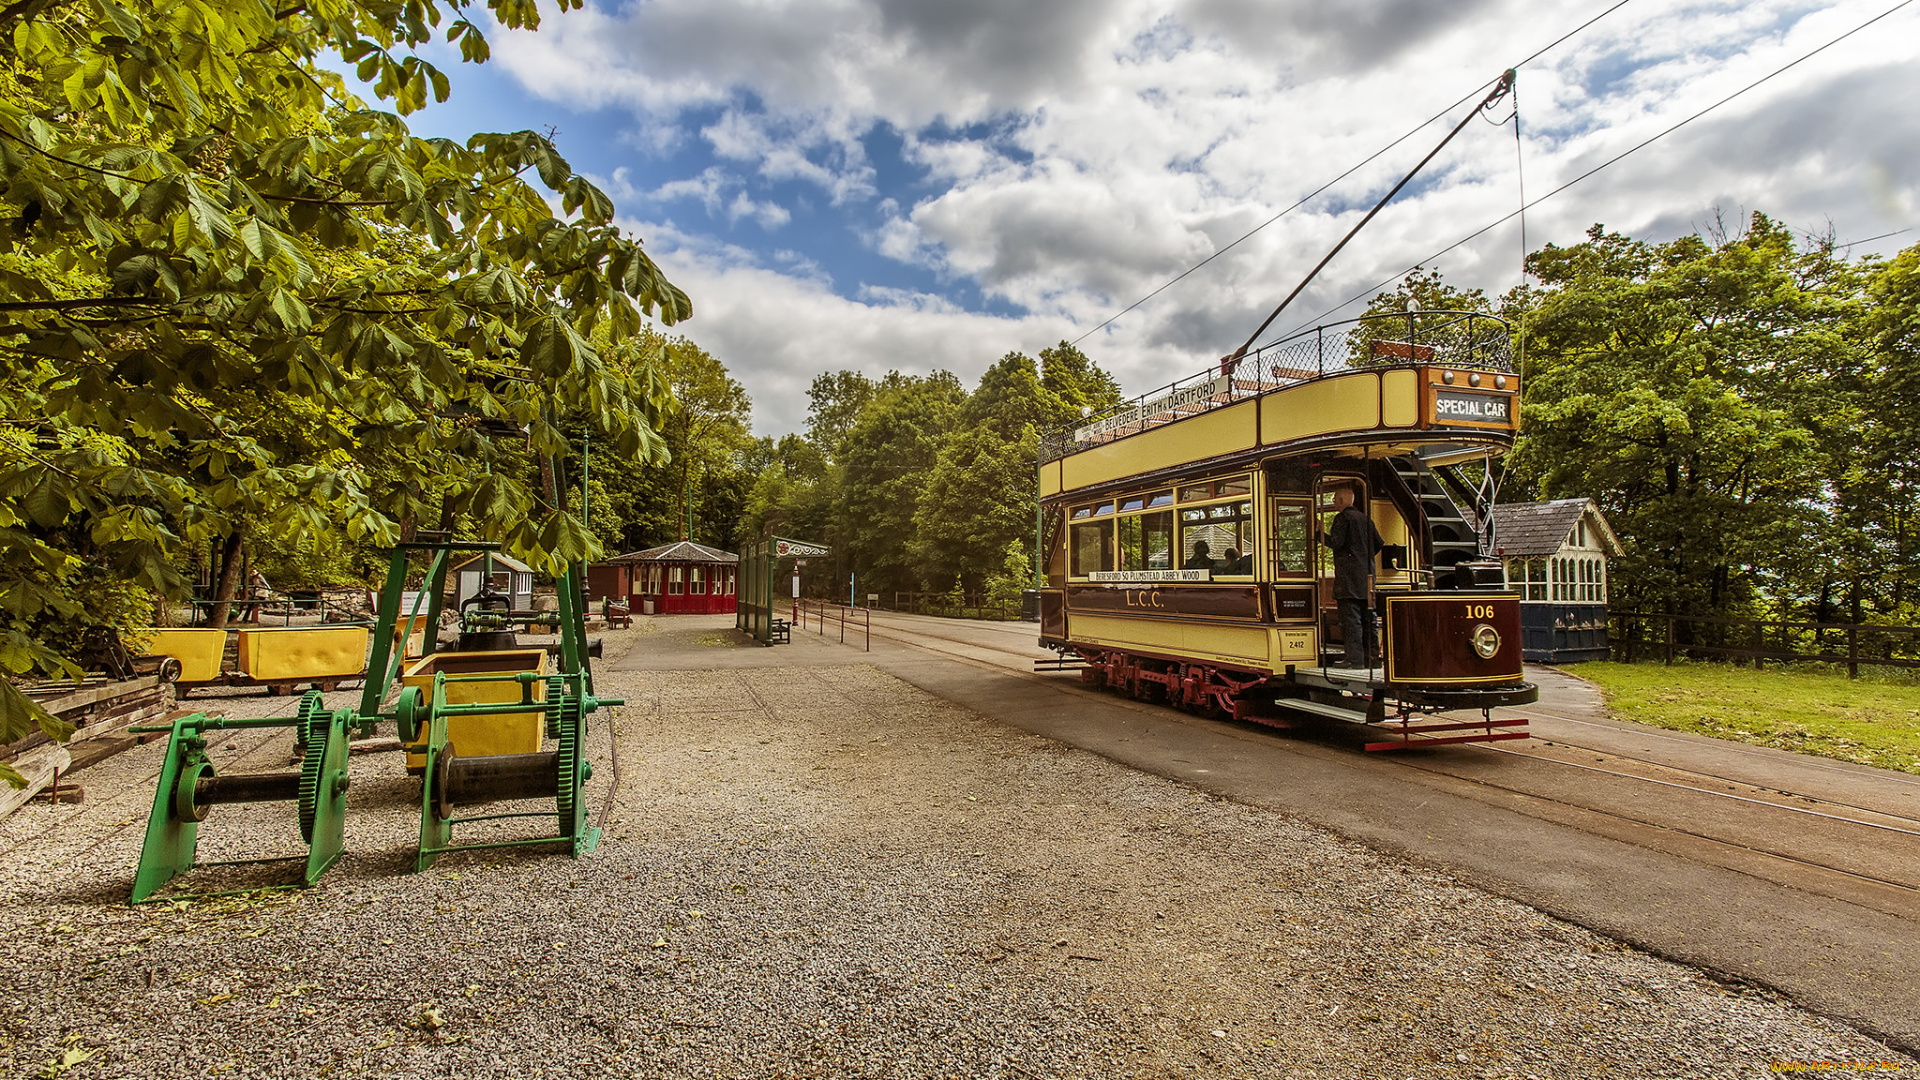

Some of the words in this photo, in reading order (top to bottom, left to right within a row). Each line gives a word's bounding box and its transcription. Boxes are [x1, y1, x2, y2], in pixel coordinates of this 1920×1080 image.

[1105, 409, 1139, 430] BELVEDERE
[1142, 402, 1163, 418] ERITH
[1168, 382, 1216, 409] DARTFORD
[1436, 399, 1483, 416] SPECIAL
[1484, 402, 1506, 417] CAR
[1096, 572, 1120, 580] BERESFORD
[1130, 571, 1160, 580] PLUMSTEAD
[1162, 571, 1180, 580] ABBEY
[1182, 570, 1200, 580] WOOD
[1465, 604, 1495, 619] 106
